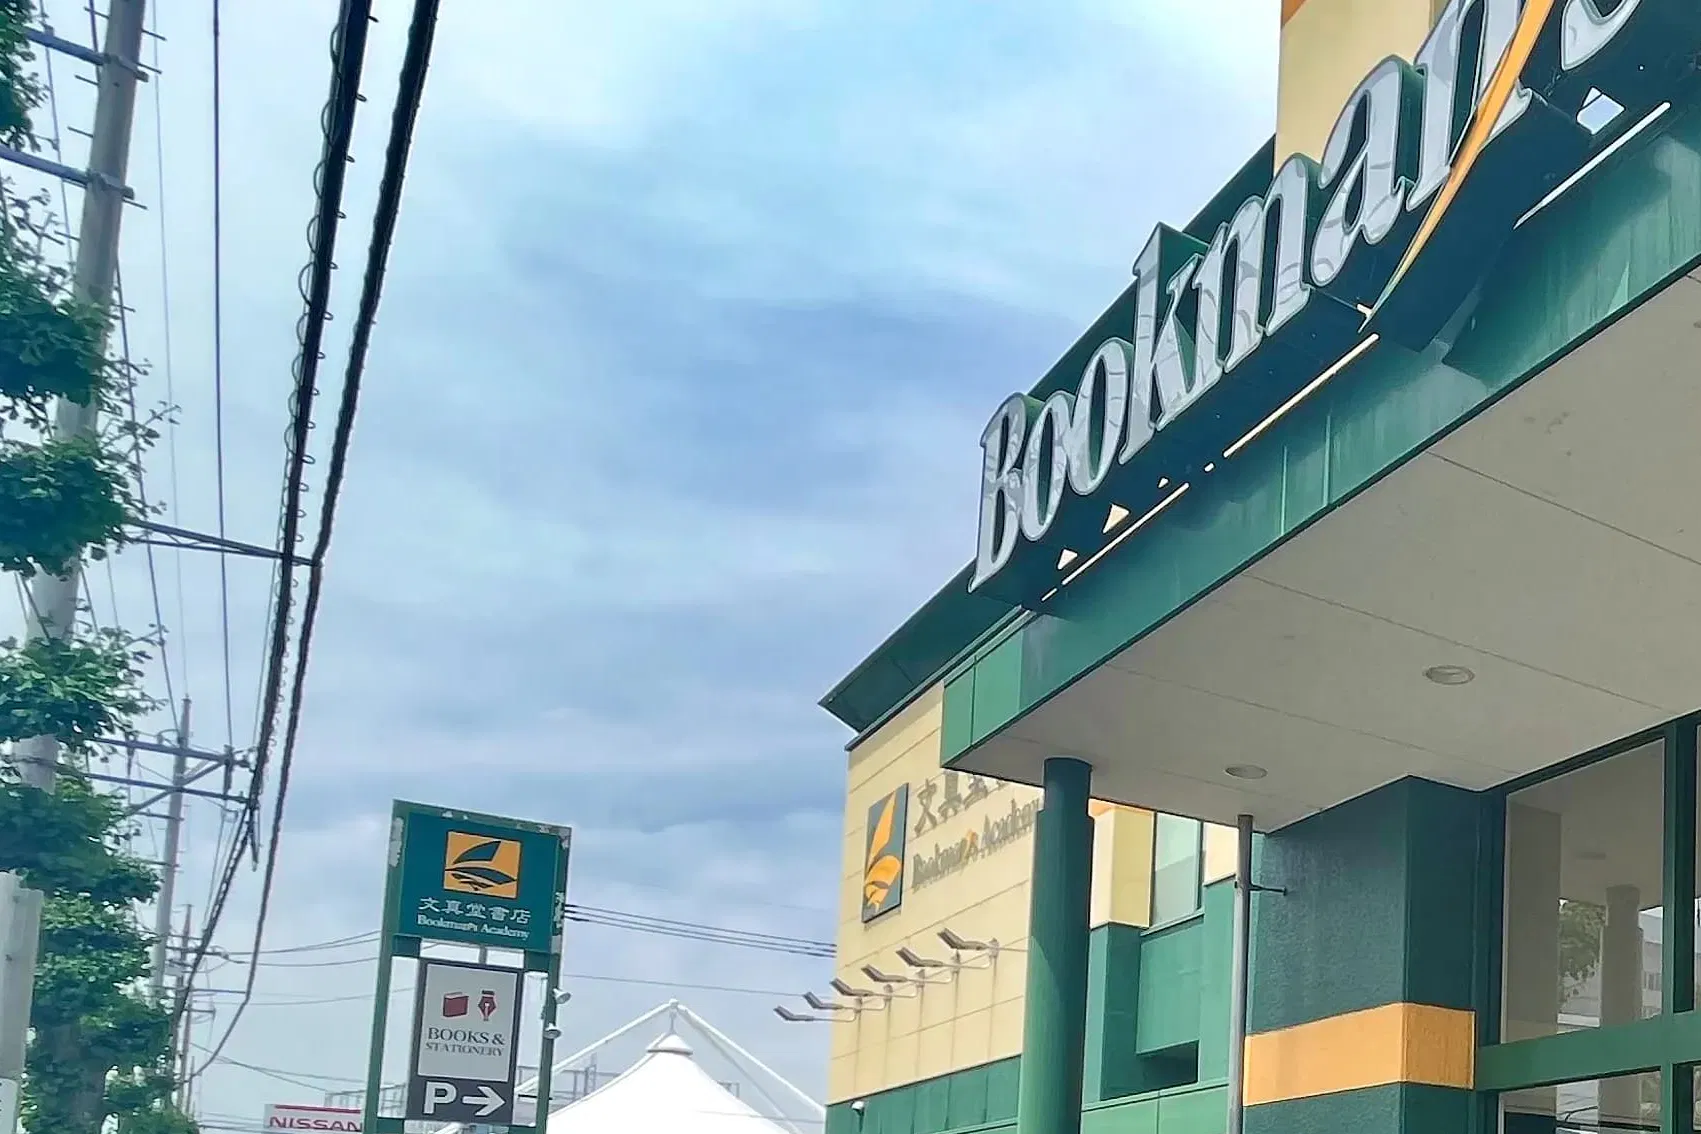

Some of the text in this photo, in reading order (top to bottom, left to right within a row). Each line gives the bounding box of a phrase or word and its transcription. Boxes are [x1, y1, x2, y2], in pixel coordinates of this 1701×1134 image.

[967, 0, 1641, 593] Bookman
[418, 897, 531, 925] 文真堂書店
[480, 923, 531, 940] Academy
[428, 1027, 505, 1046] BOOKS &
[425, 1042, 504, 1057] STATIONERY
[423, 1080, 457, 1115] P
[269, 1116, 363, 1132] NISSAN
